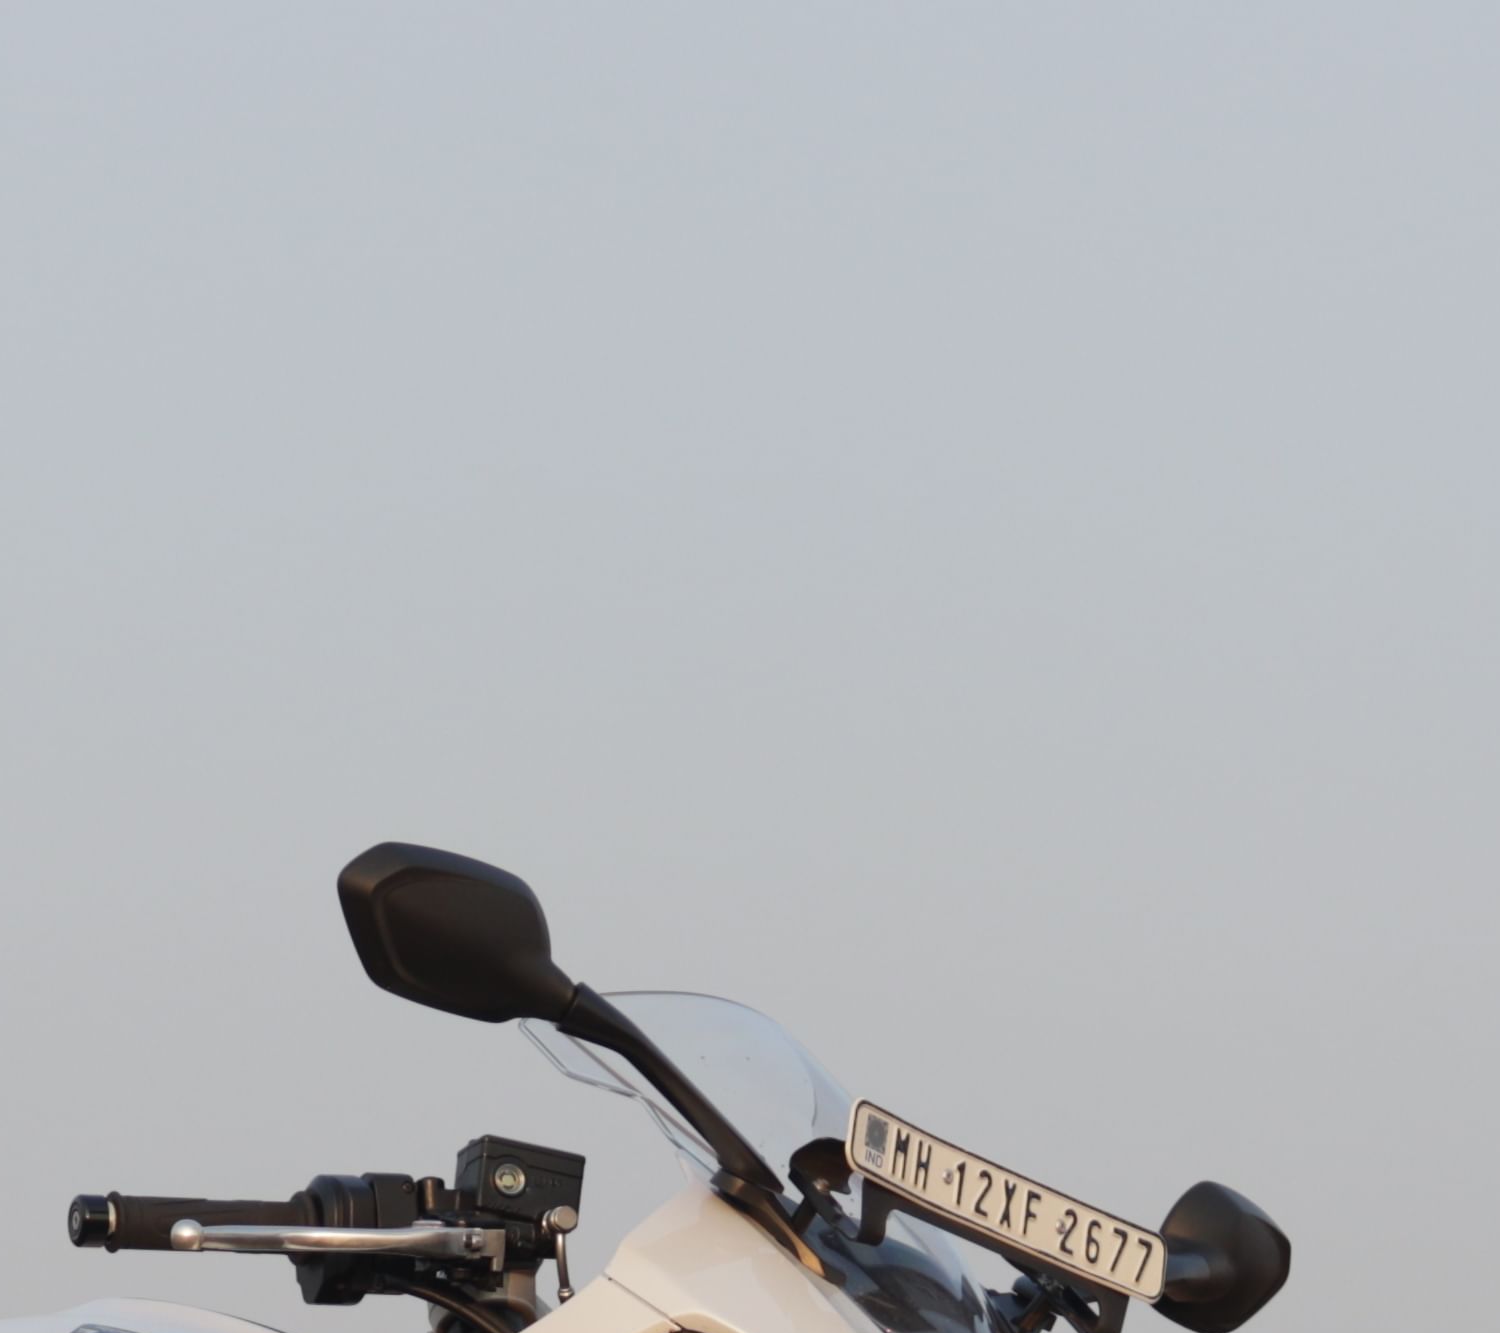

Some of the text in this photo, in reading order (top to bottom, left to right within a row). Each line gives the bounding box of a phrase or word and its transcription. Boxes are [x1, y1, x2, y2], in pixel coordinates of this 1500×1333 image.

[864, 1148, 884, 1169] IND
[891, 1127, 932, 1192] MH
[1060, 1208, 1153, 1284] 2677
